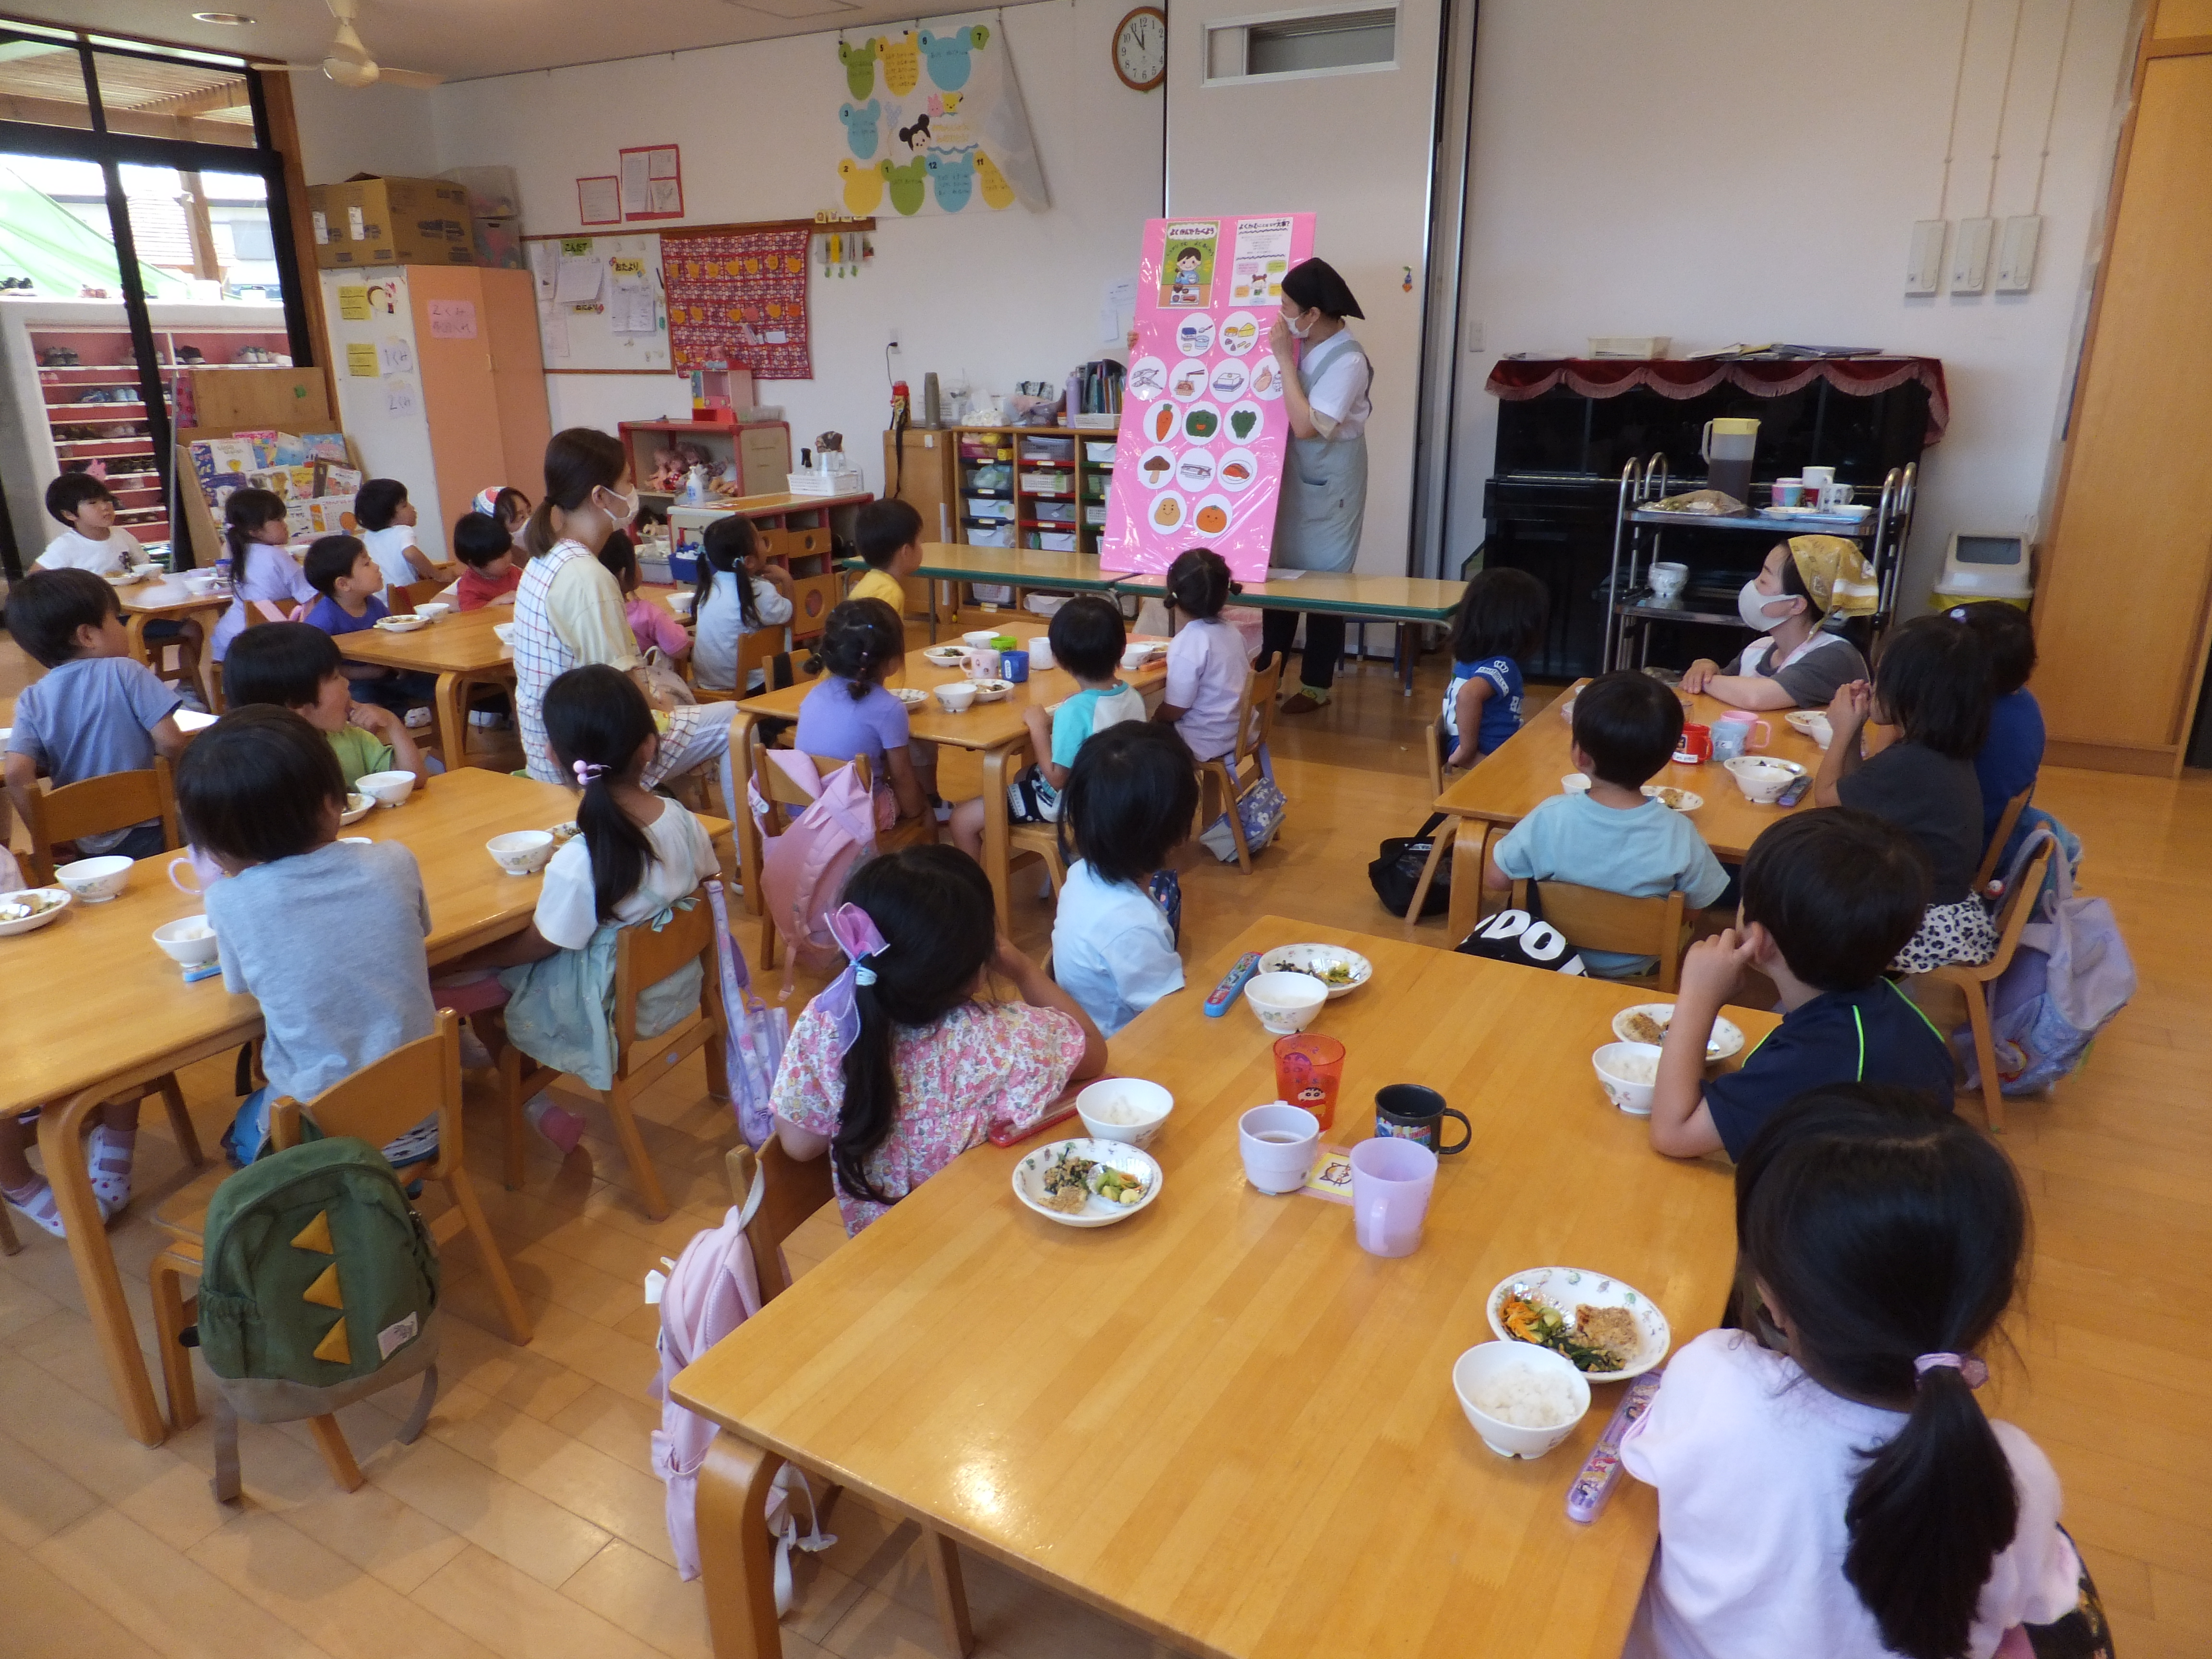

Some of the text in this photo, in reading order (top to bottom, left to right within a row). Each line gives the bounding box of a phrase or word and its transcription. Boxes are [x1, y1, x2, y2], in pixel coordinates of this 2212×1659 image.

[1140, 17, 1147, 27] 12
[1152, 20, 1154, 29] 1
[1159, 28, 1163, 37] 2
[923, 36, 927, 45] 6
[1123, 33, 1130, 43] 10
[1121, 47, 1126, 56] 9
[1125, 60, 1130, 69] 8
[1133, 68, 1137, 77] 7
[1142, 71, 1147, 79] 6
[1152, 66, 1156, 75] 5
[565, 242, 587, 252] こんだて
[615, 262, 638, 272] おたより
